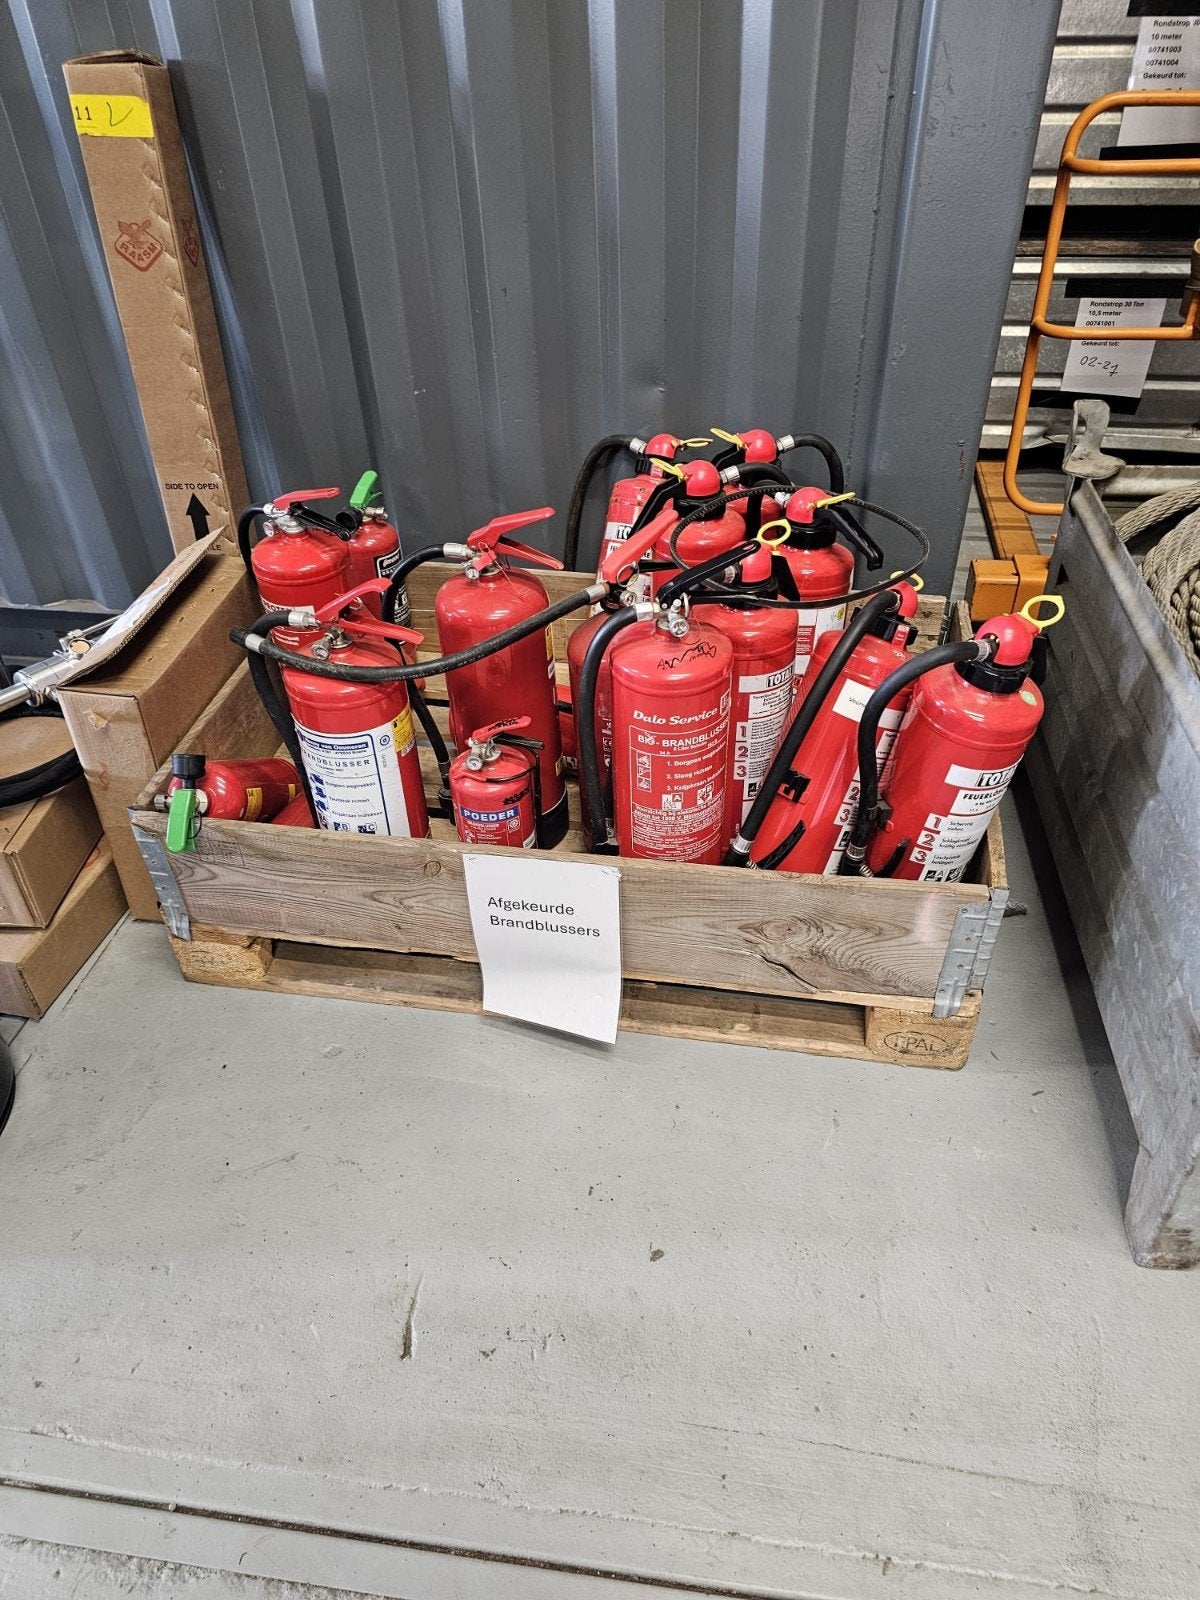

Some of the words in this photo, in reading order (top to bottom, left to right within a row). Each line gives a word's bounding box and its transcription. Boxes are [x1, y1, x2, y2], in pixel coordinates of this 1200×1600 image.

[120, 242, 158, 262] RAASM
[633, 710, 667, 725] Dalo
[669, 708, 718, 725] Service
[674, 770, 693, 780] Slang
[463, 809, 515, 822] POEDER
[487, 897, 575, 915] Afgekeurde
[490, 915, 601, 937] Brandblussers
